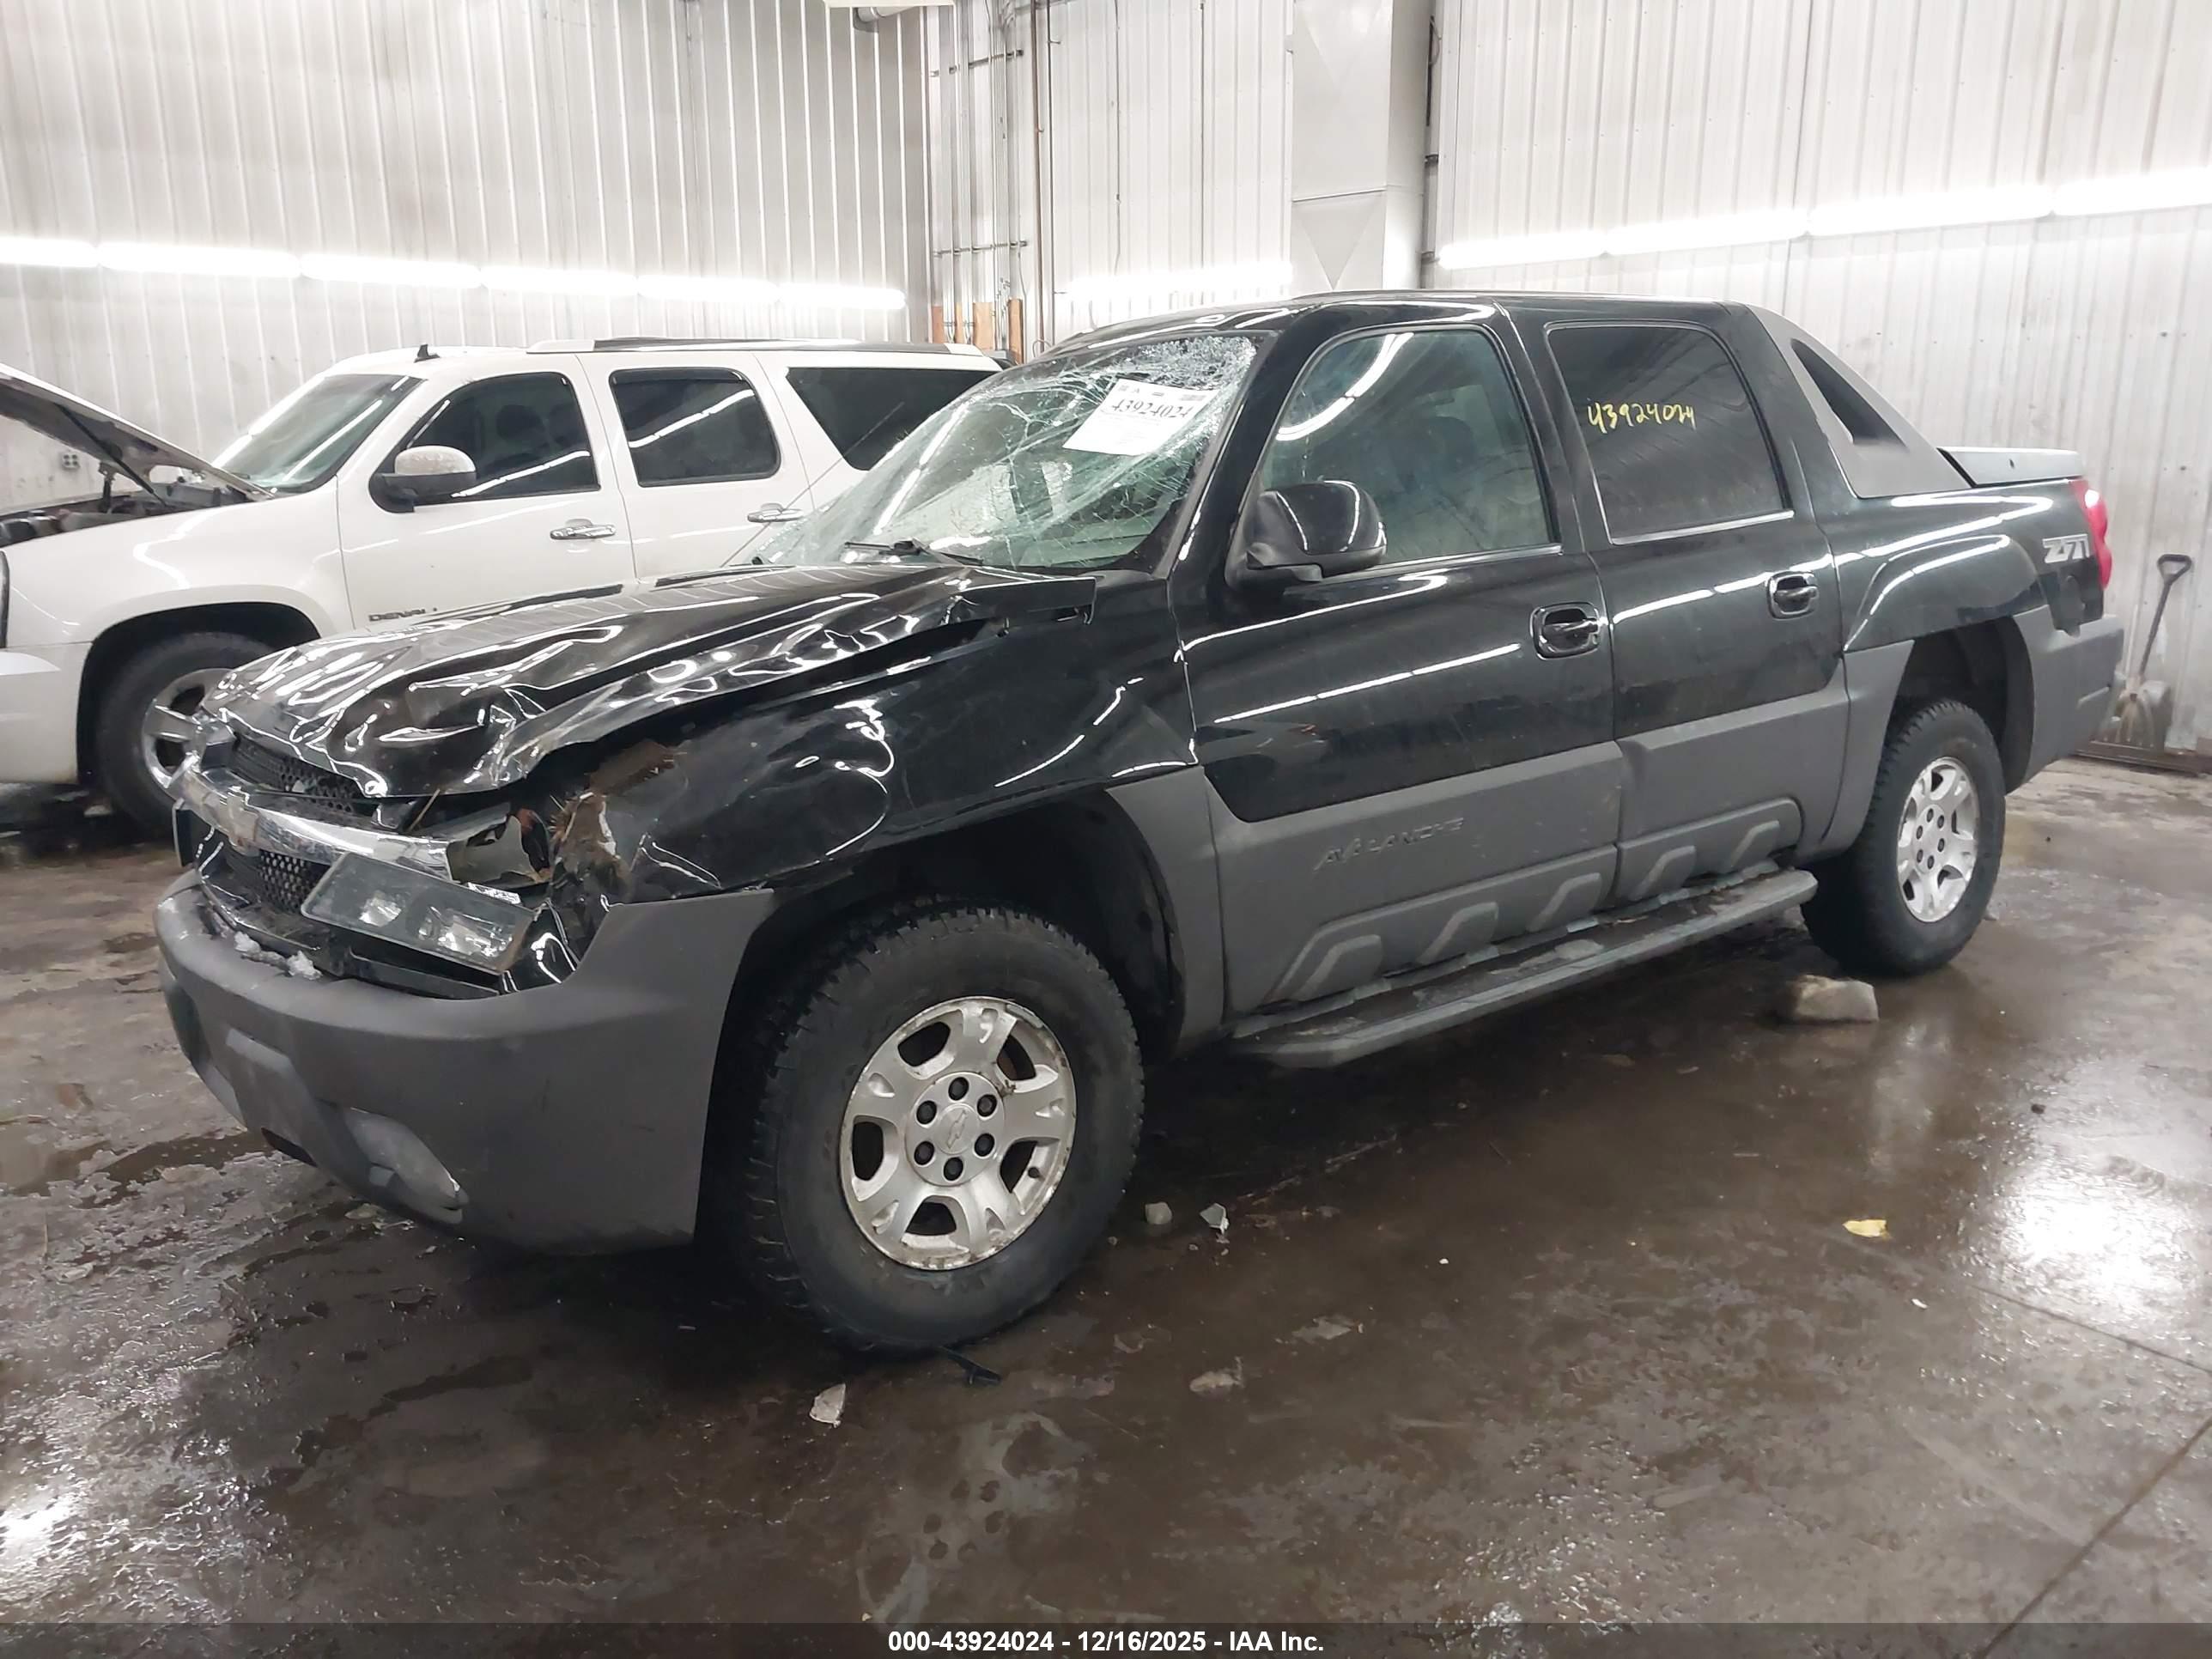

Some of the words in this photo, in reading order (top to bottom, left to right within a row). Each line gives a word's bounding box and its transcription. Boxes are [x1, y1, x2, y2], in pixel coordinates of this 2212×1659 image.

[1112, 398, 1194, 418] 43924024
[1587, 402, 1696, 434] 43924024
[2042, 533, 2090, 563] Z71
